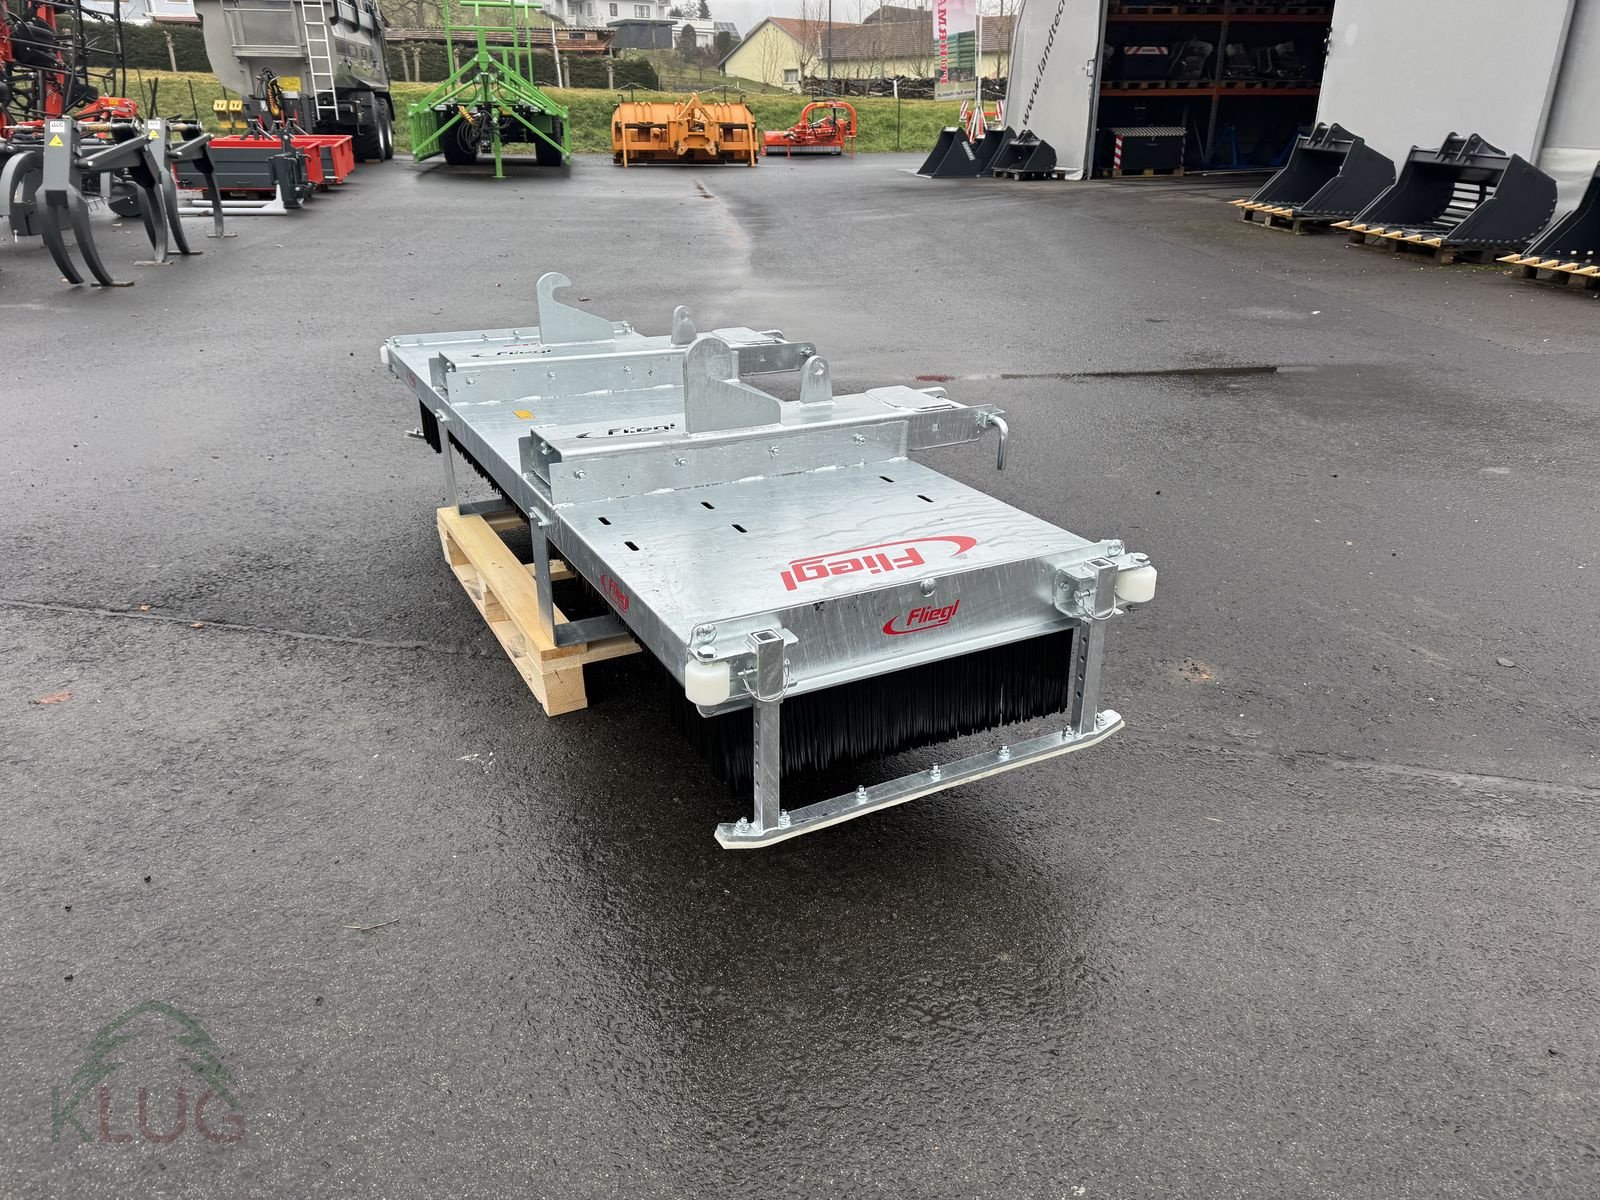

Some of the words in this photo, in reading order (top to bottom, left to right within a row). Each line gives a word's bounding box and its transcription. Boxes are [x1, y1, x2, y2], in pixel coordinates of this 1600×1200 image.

[780, 547, 925, 591] Fliegl
[608, 577, 630, 611] Fliegl
[906, 599, 960, 626] Fliegl
